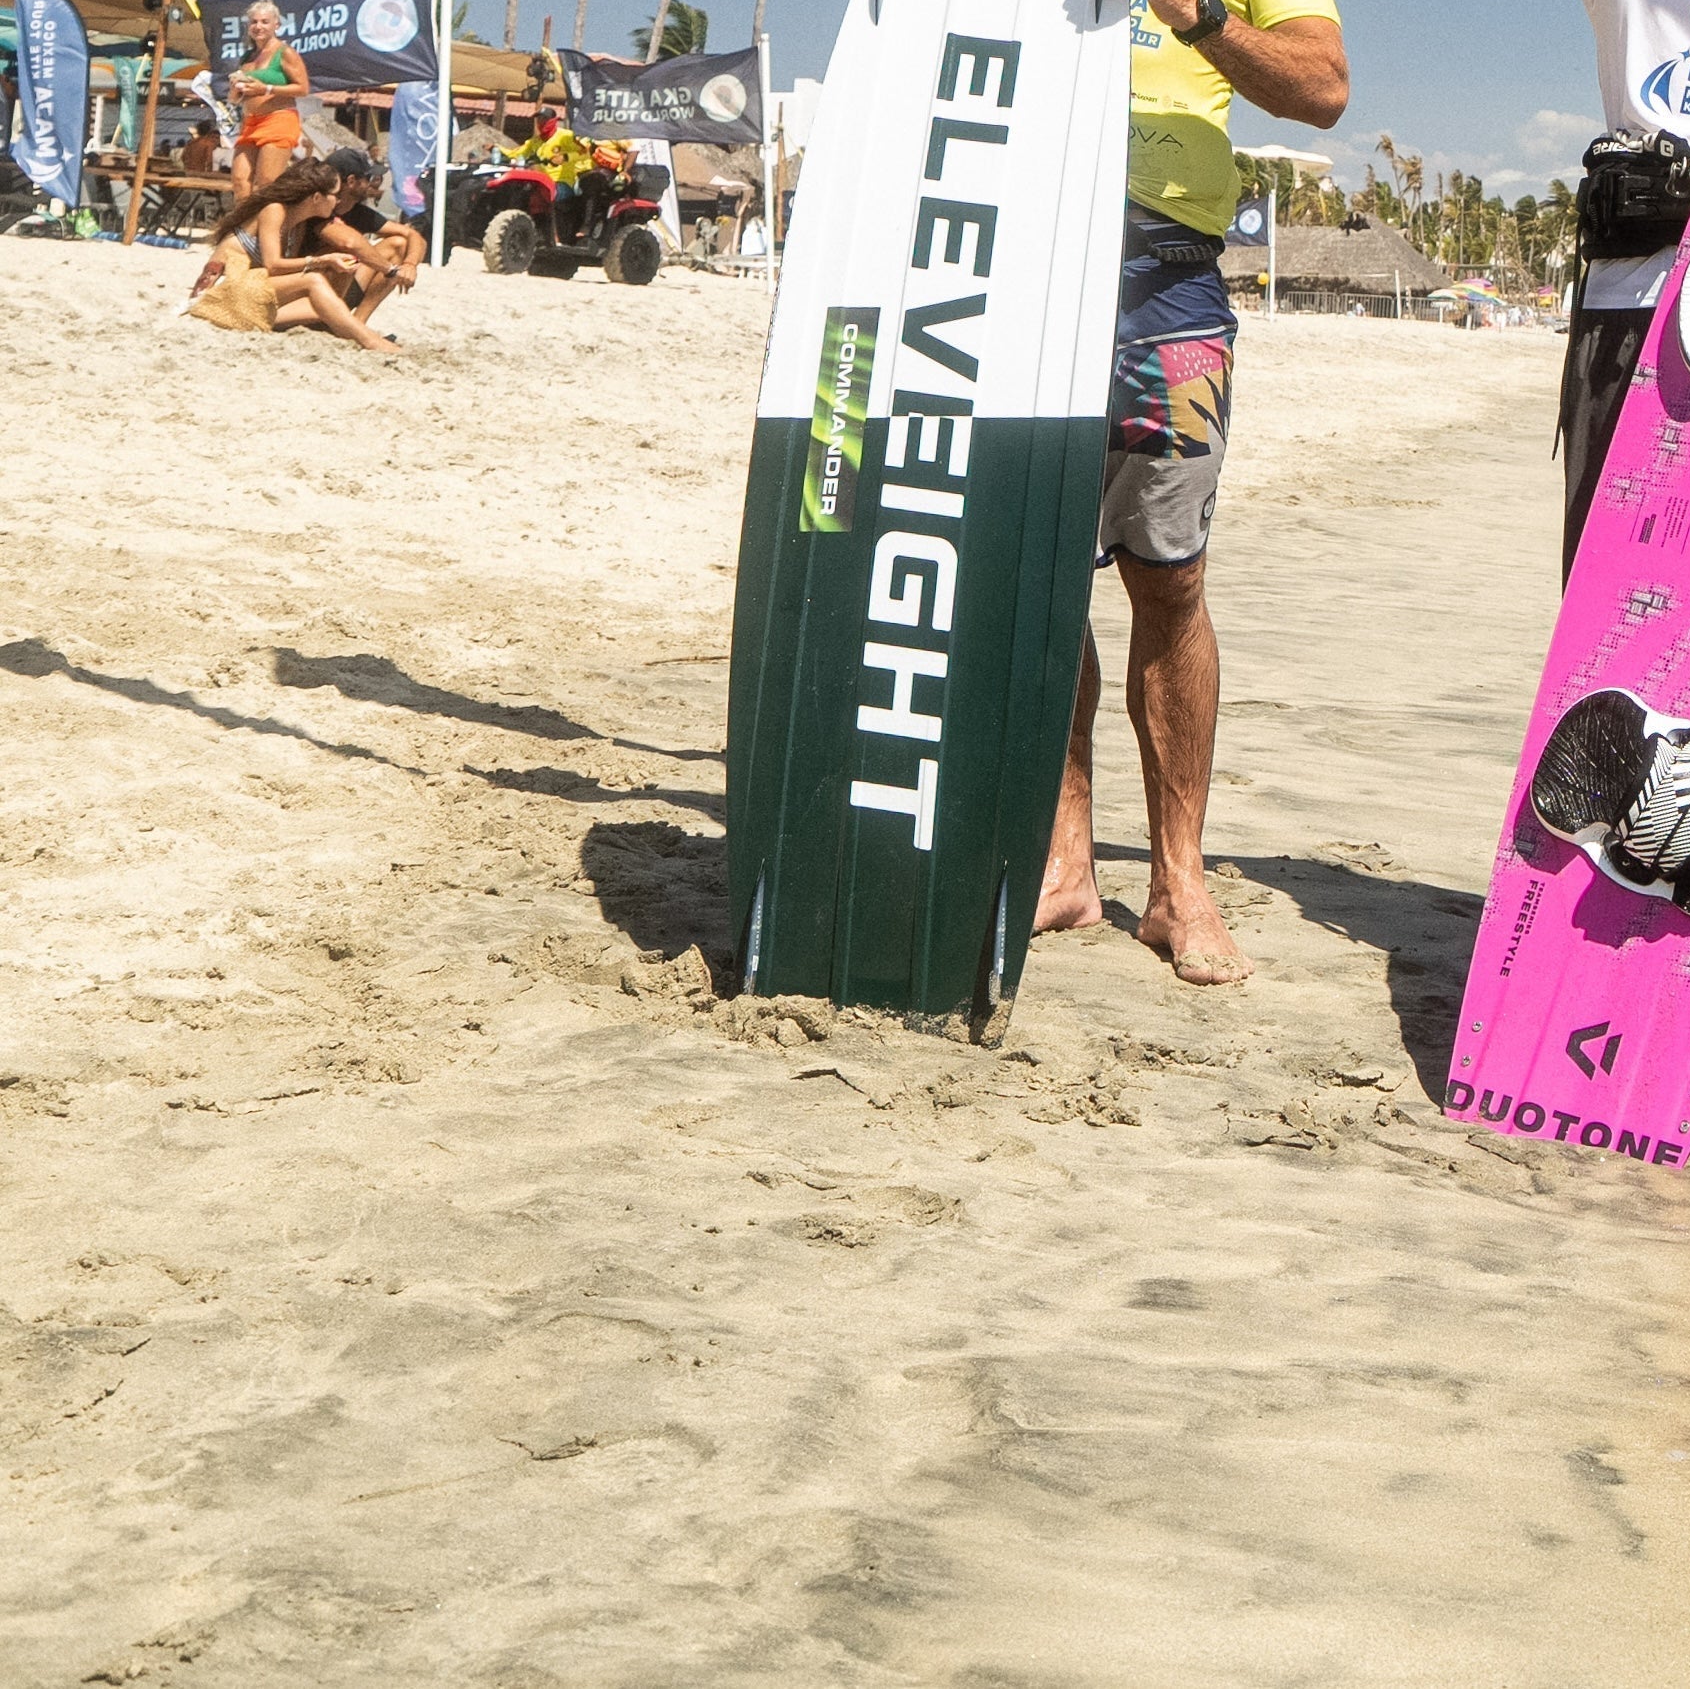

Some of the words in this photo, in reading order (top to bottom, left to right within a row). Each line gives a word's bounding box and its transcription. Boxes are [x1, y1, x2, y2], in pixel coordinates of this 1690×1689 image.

[820, 323, 858, 515] COMMANDER
[850, 33, 1022, 850] ELEVEIGHT
[1500, 879, 1539, 977] FREESTYLE
[1444, 1079, 1684, 1165] DUOTONE
